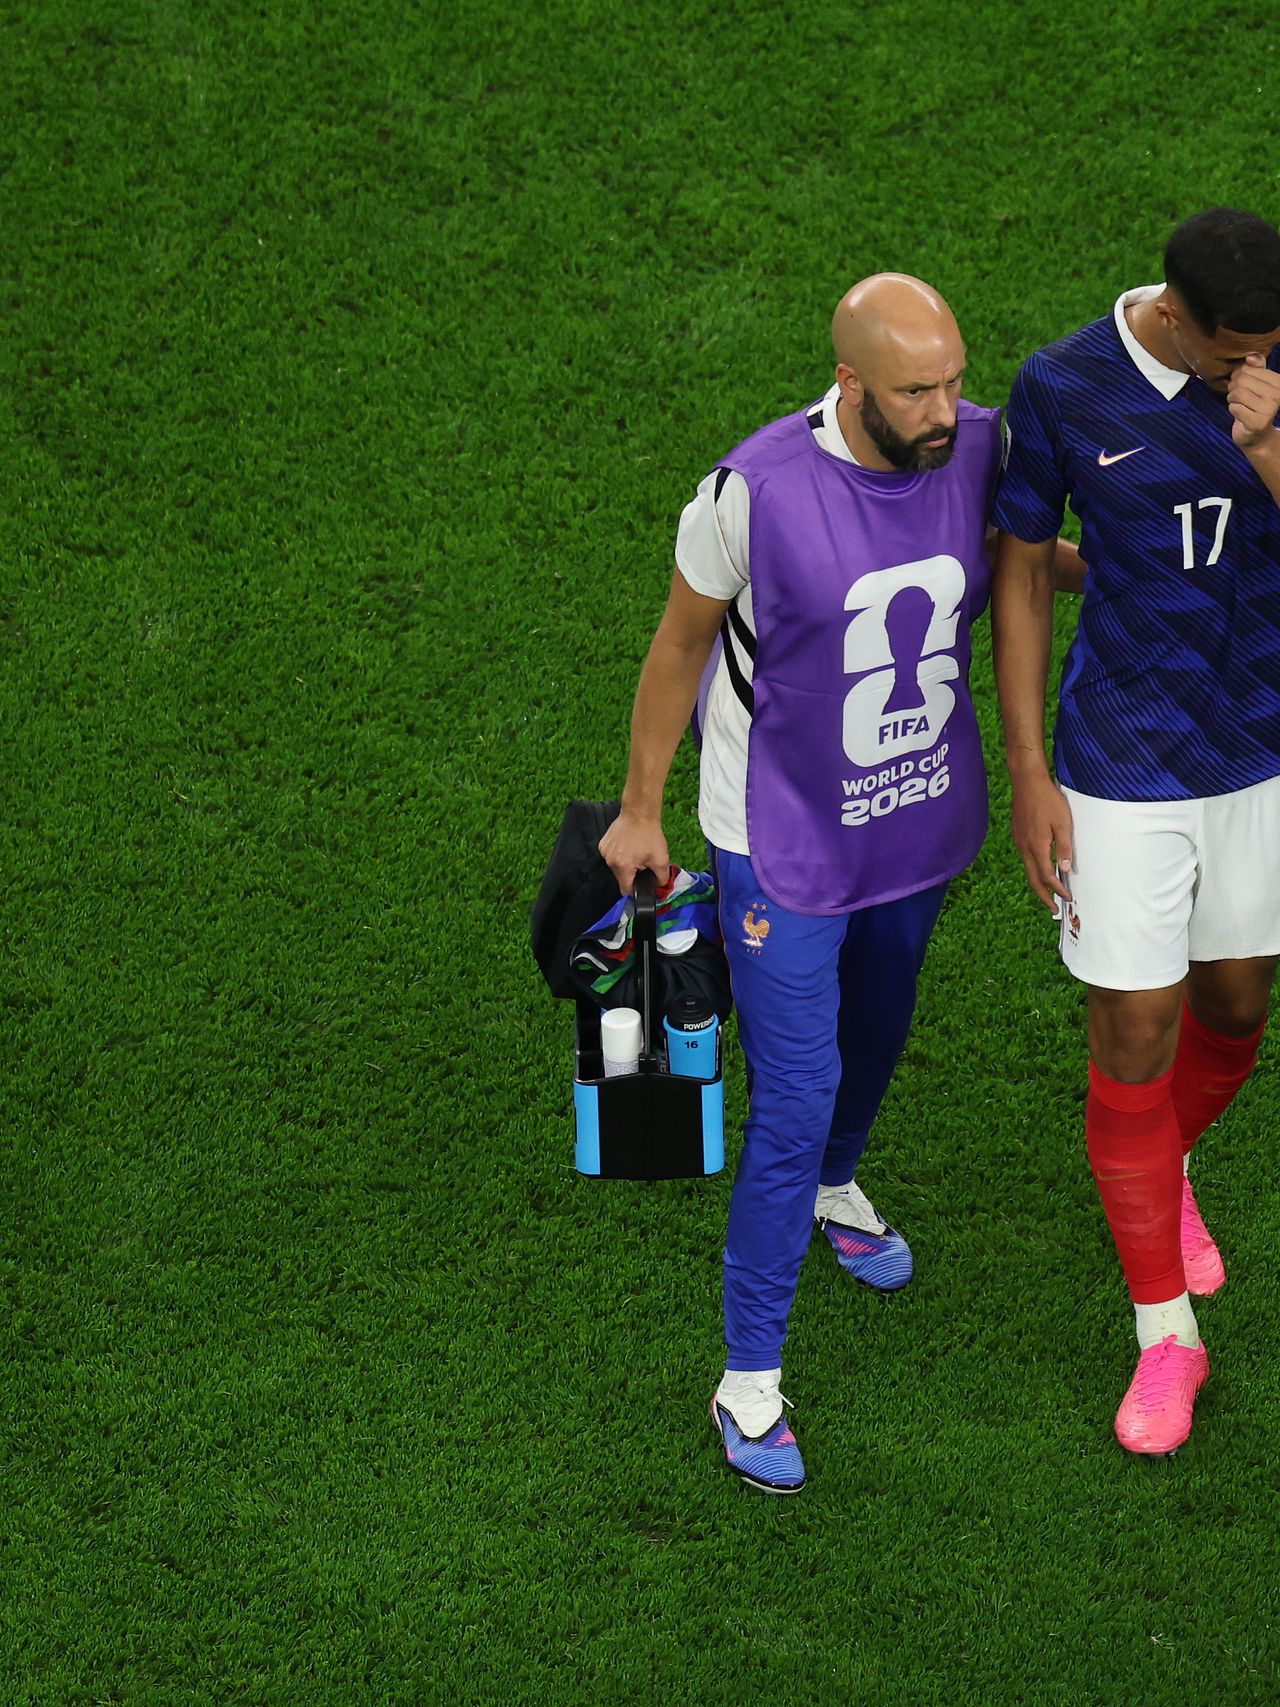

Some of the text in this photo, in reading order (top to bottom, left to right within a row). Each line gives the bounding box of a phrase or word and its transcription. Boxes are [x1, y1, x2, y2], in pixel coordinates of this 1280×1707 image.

[1174, 496, 1232, 570] 17
[879, 715, 930, 746] FIFA
[841, 743, 949, 796] WORLD CUP
[841, 765, 950, 826] 2026
[684, 1041, 699, 1049] 16
